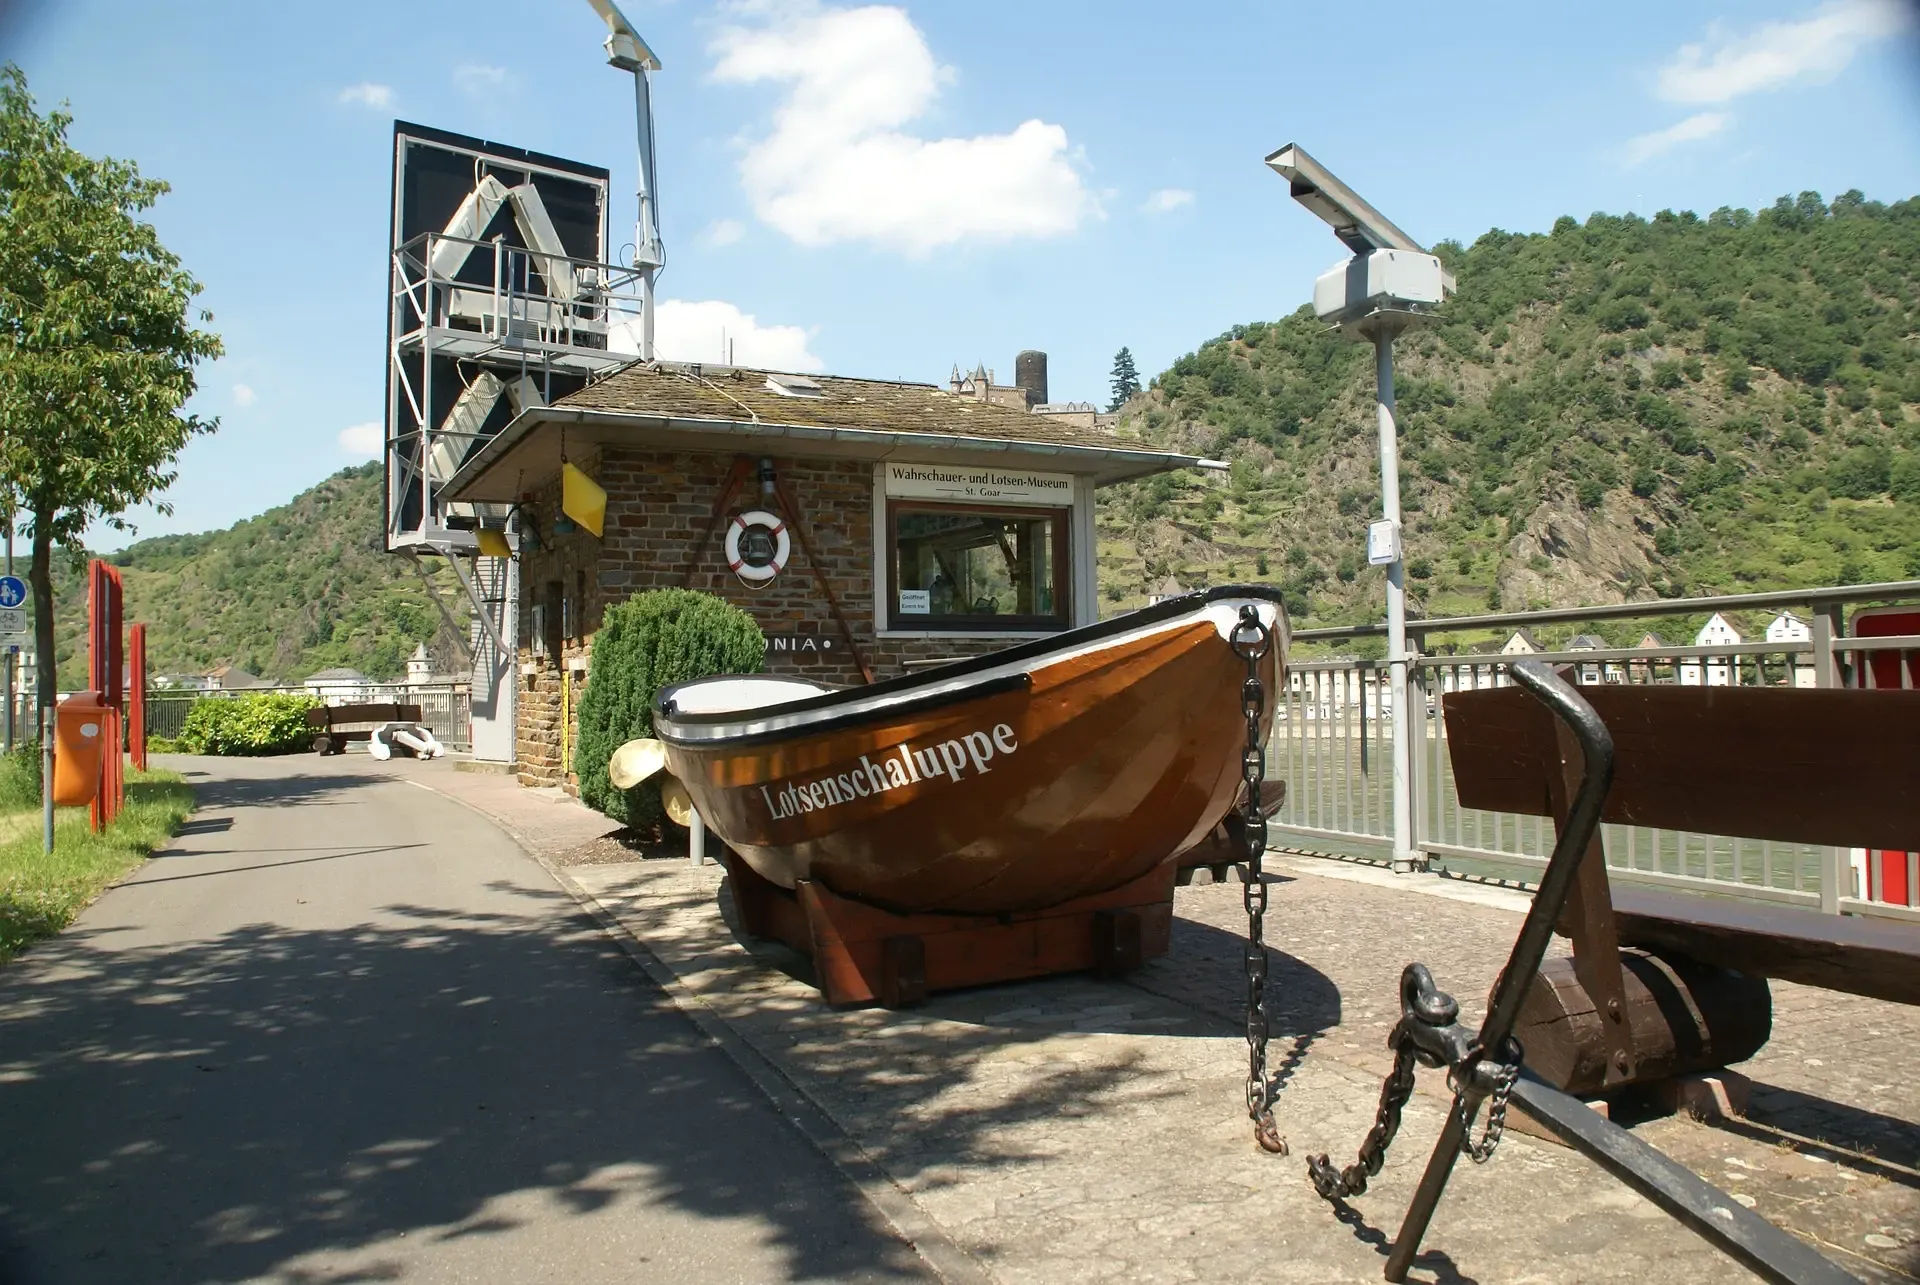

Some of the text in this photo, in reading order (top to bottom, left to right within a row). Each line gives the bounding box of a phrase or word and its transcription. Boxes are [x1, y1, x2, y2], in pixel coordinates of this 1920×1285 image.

[892, 467, 1068, 490] Wahrschauer- und Lotsen-Museum
[965, 487, 1001, 497] St. Goar
[760, 722, 1018, 820] Lotsenschaluppe
